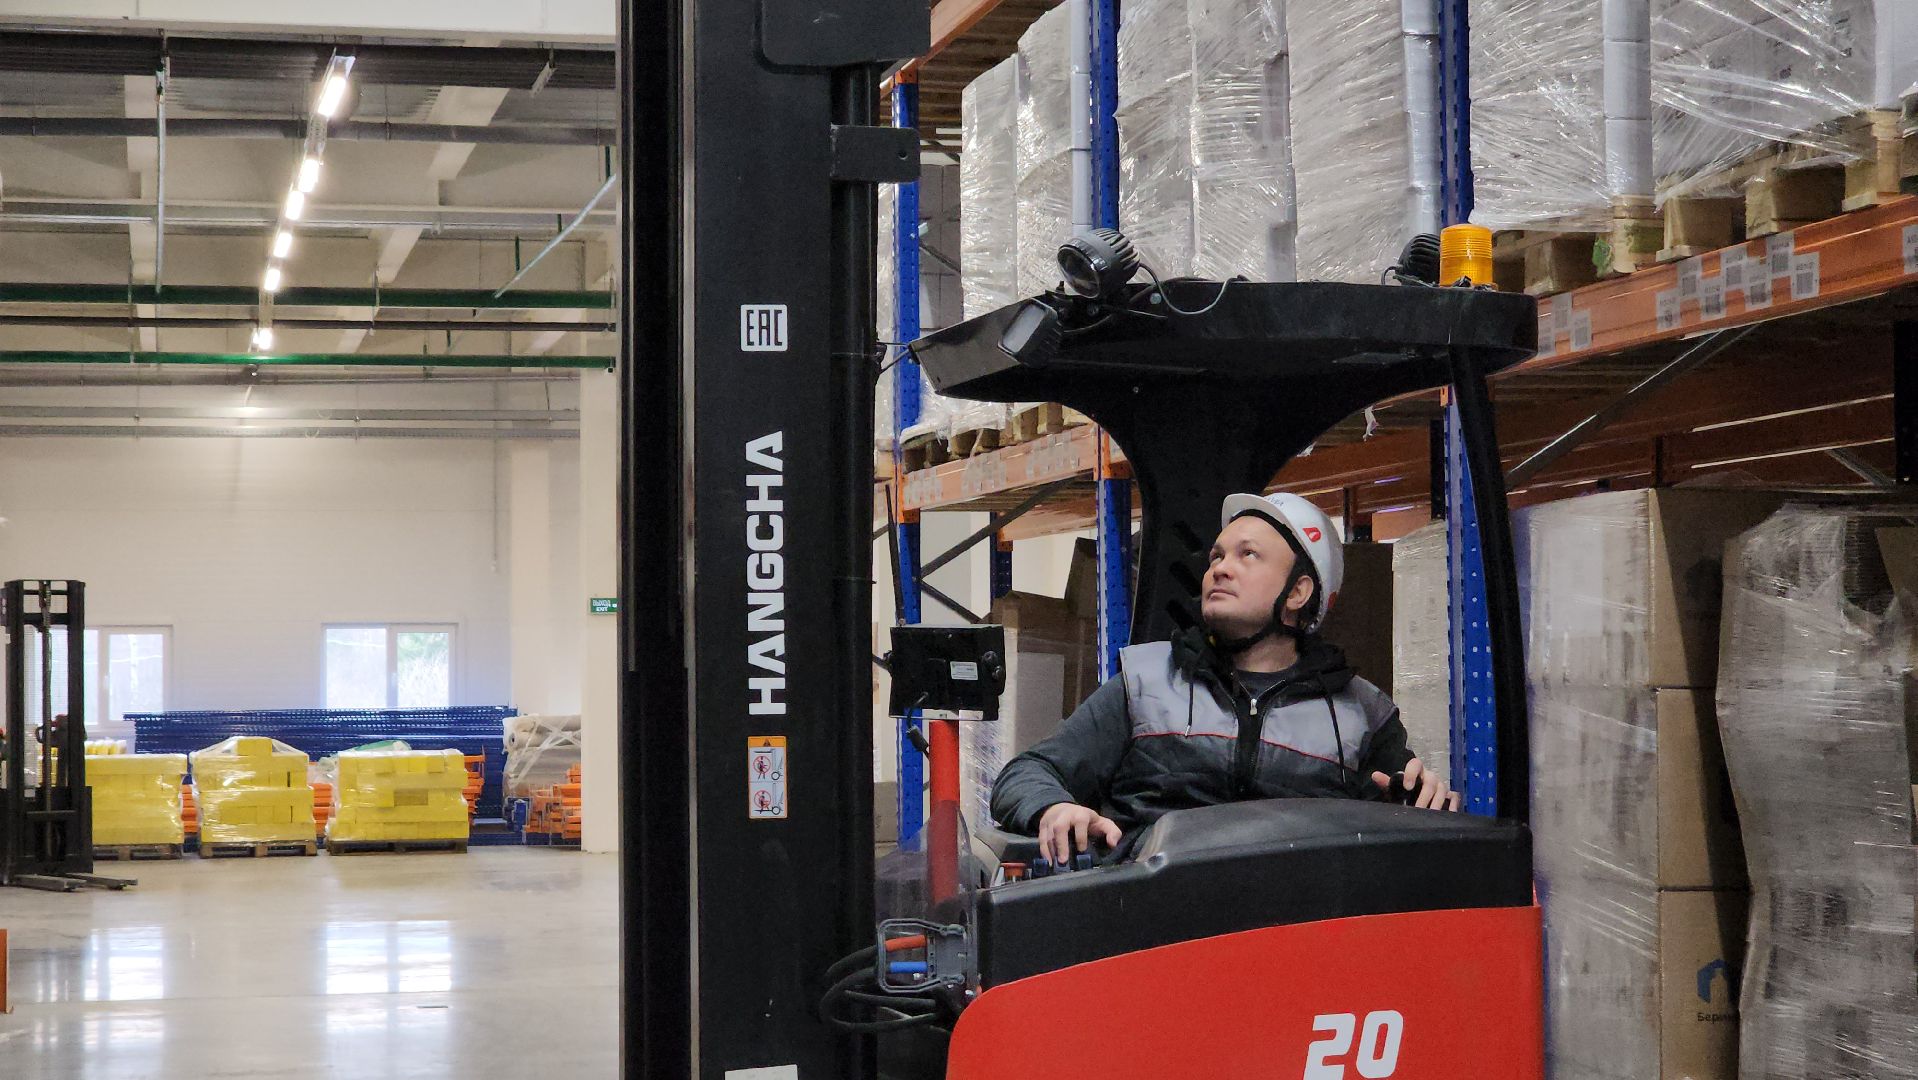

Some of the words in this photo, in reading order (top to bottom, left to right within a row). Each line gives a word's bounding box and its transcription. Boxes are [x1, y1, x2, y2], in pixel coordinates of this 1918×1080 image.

[746, 309, 783, 347] EAC
[746, 430, 787, 715] HANGCHA
[1303, 1009, 1404, 1080] 20
